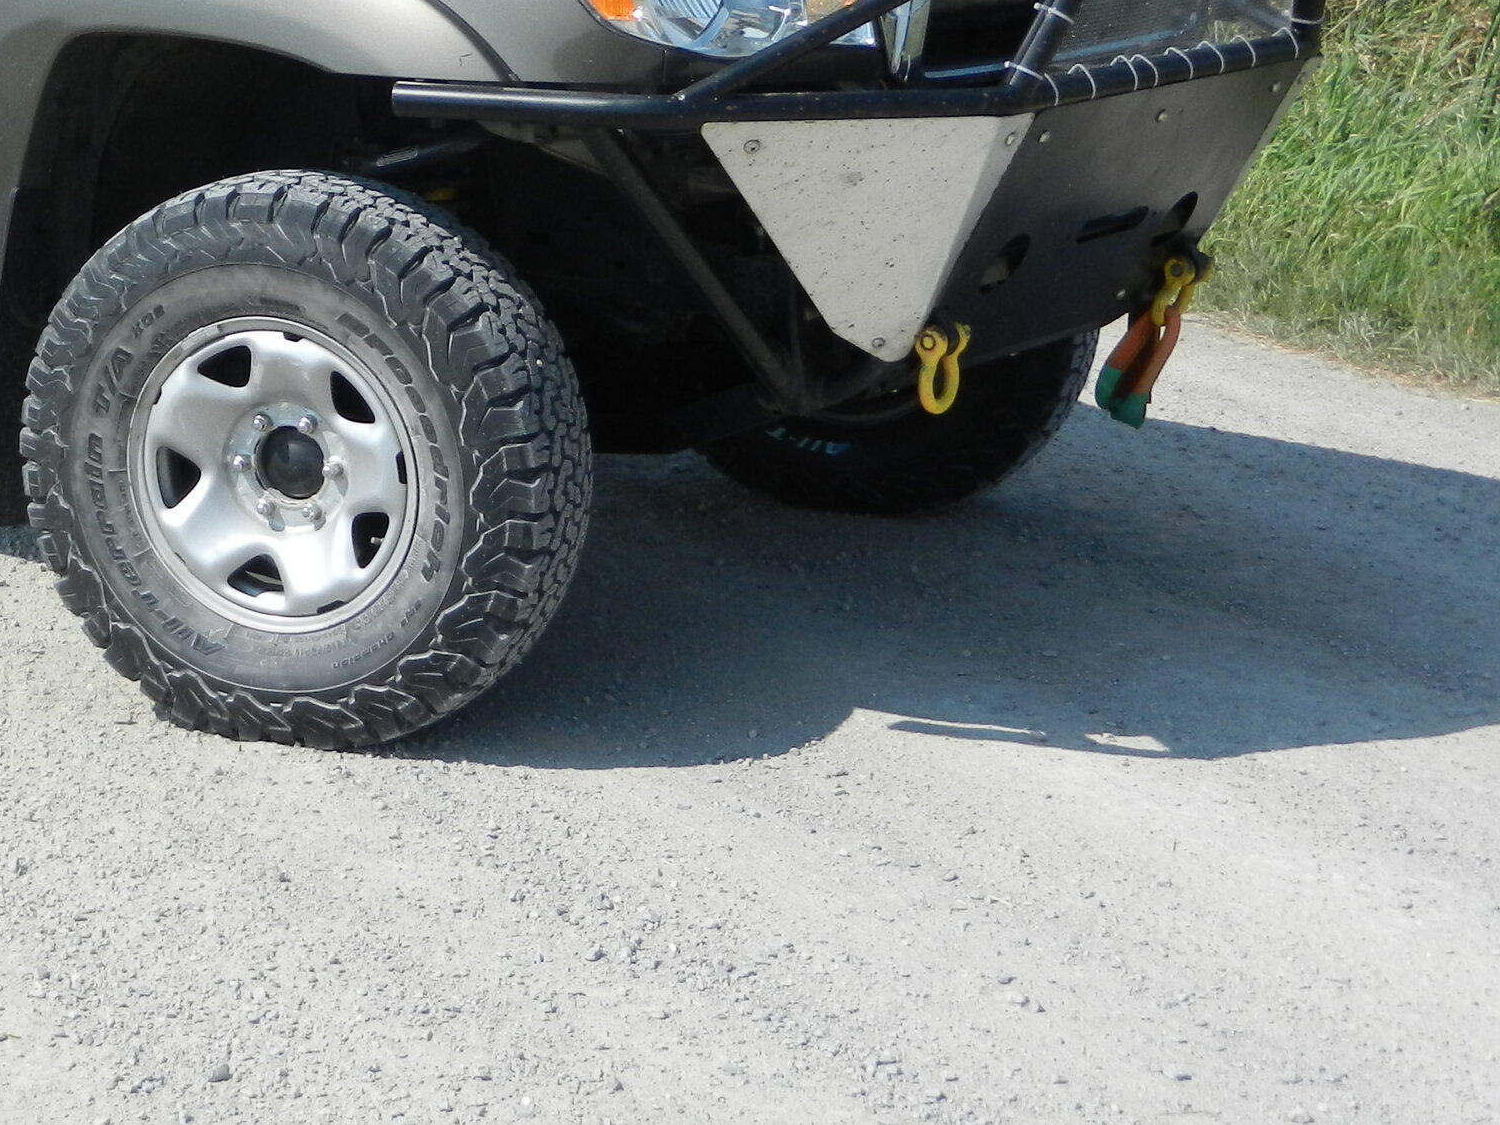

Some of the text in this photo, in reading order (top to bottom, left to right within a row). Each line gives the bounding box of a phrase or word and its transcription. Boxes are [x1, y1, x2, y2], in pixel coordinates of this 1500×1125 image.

[93, 347, 134, 415] T/A
[83, 432, 226, 657] All-Terrain
[331, 630, 396, 670] Champion
